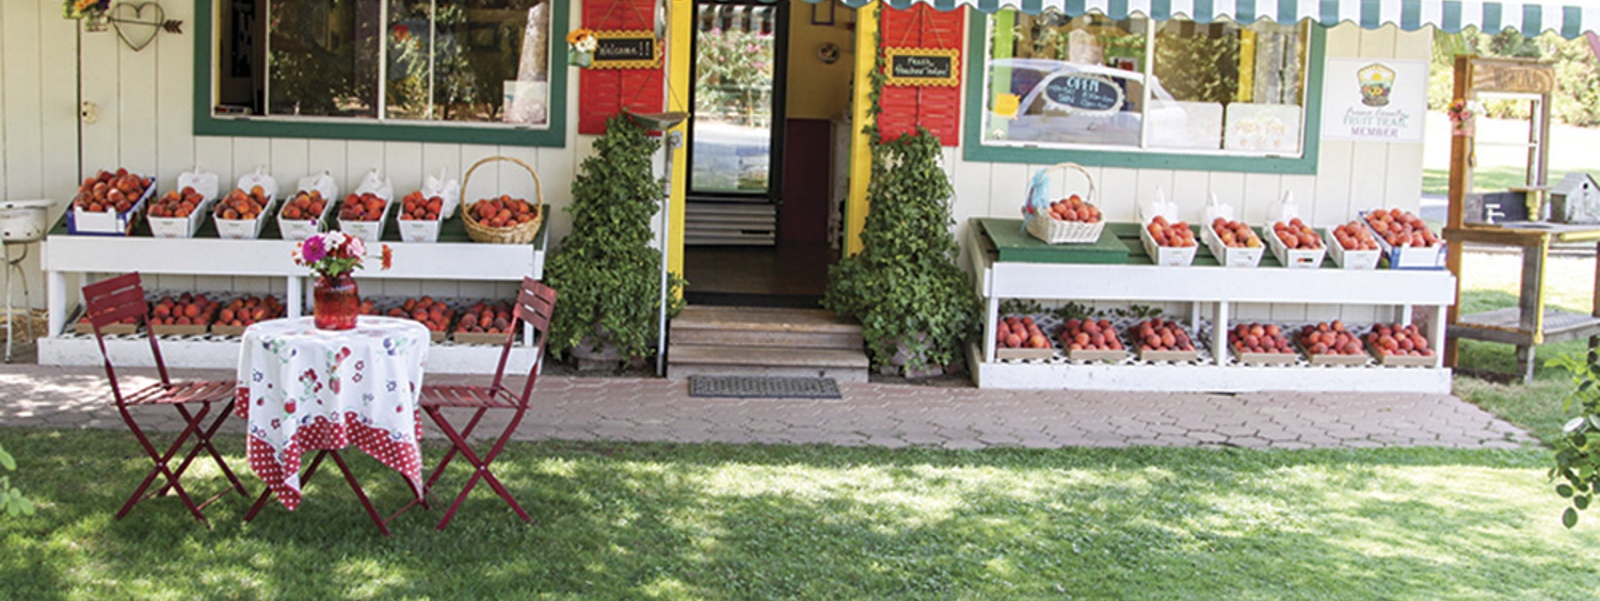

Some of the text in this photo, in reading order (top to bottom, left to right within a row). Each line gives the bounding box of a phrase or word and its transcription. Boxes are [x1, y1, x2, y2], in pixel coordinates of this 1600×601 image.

[1067, 76, 1099, 93] OPEN
[1343, 116, 1374, 126] FRUIT
[1351, 127, 1399, 138] MEMBER
